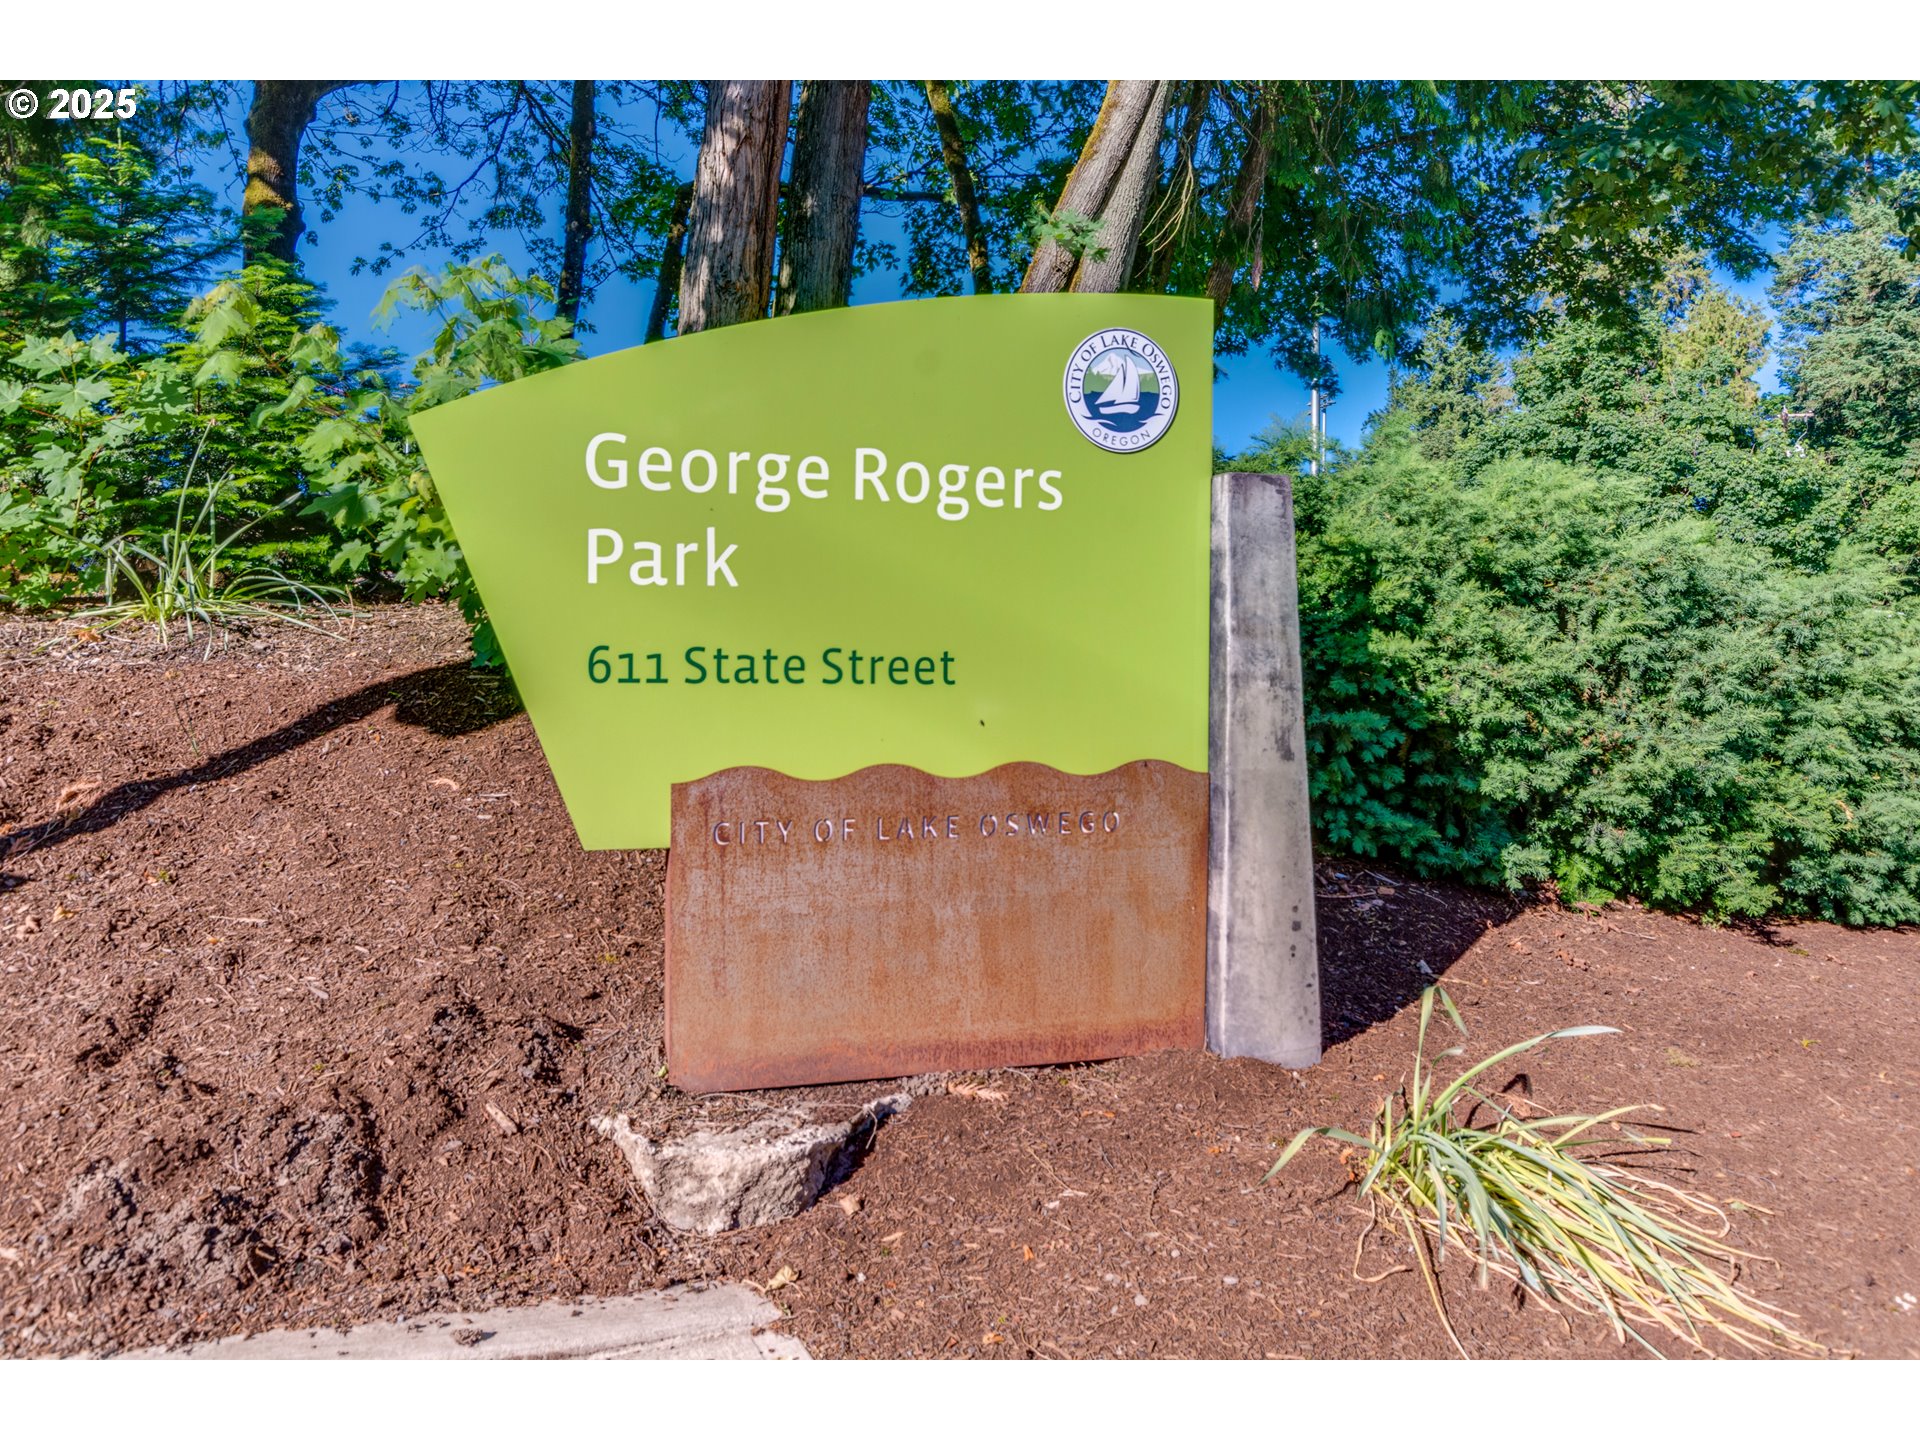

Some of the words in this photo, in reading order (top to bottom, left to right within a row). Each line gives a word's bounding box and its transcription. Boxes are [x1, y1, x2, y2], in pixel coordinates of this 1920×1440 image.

[1069, 363, 1084, 403] CITY
[1080, 342, 1097, 362] OF
[1100, 334, 1139, 348] LAKE
[1142, 343, 1172, 409] OSWEGO
[1092, 427, 1151, 446] OREGON
[585, 432, 830, 513] George
[853, 447, 1064, 522] Rogers
[587, 526, 739, 587] Park
[587, 645, 669, 685] 611
[684, 646, 806, 685] State
[821, 648, 956, 686] Street
[713, 820, 793, 846] CITY
[813, 818, 856, 843] OF
[876, 814, 961, 841] LAKE
[979, 810, 1120, 838] OSWEGO
